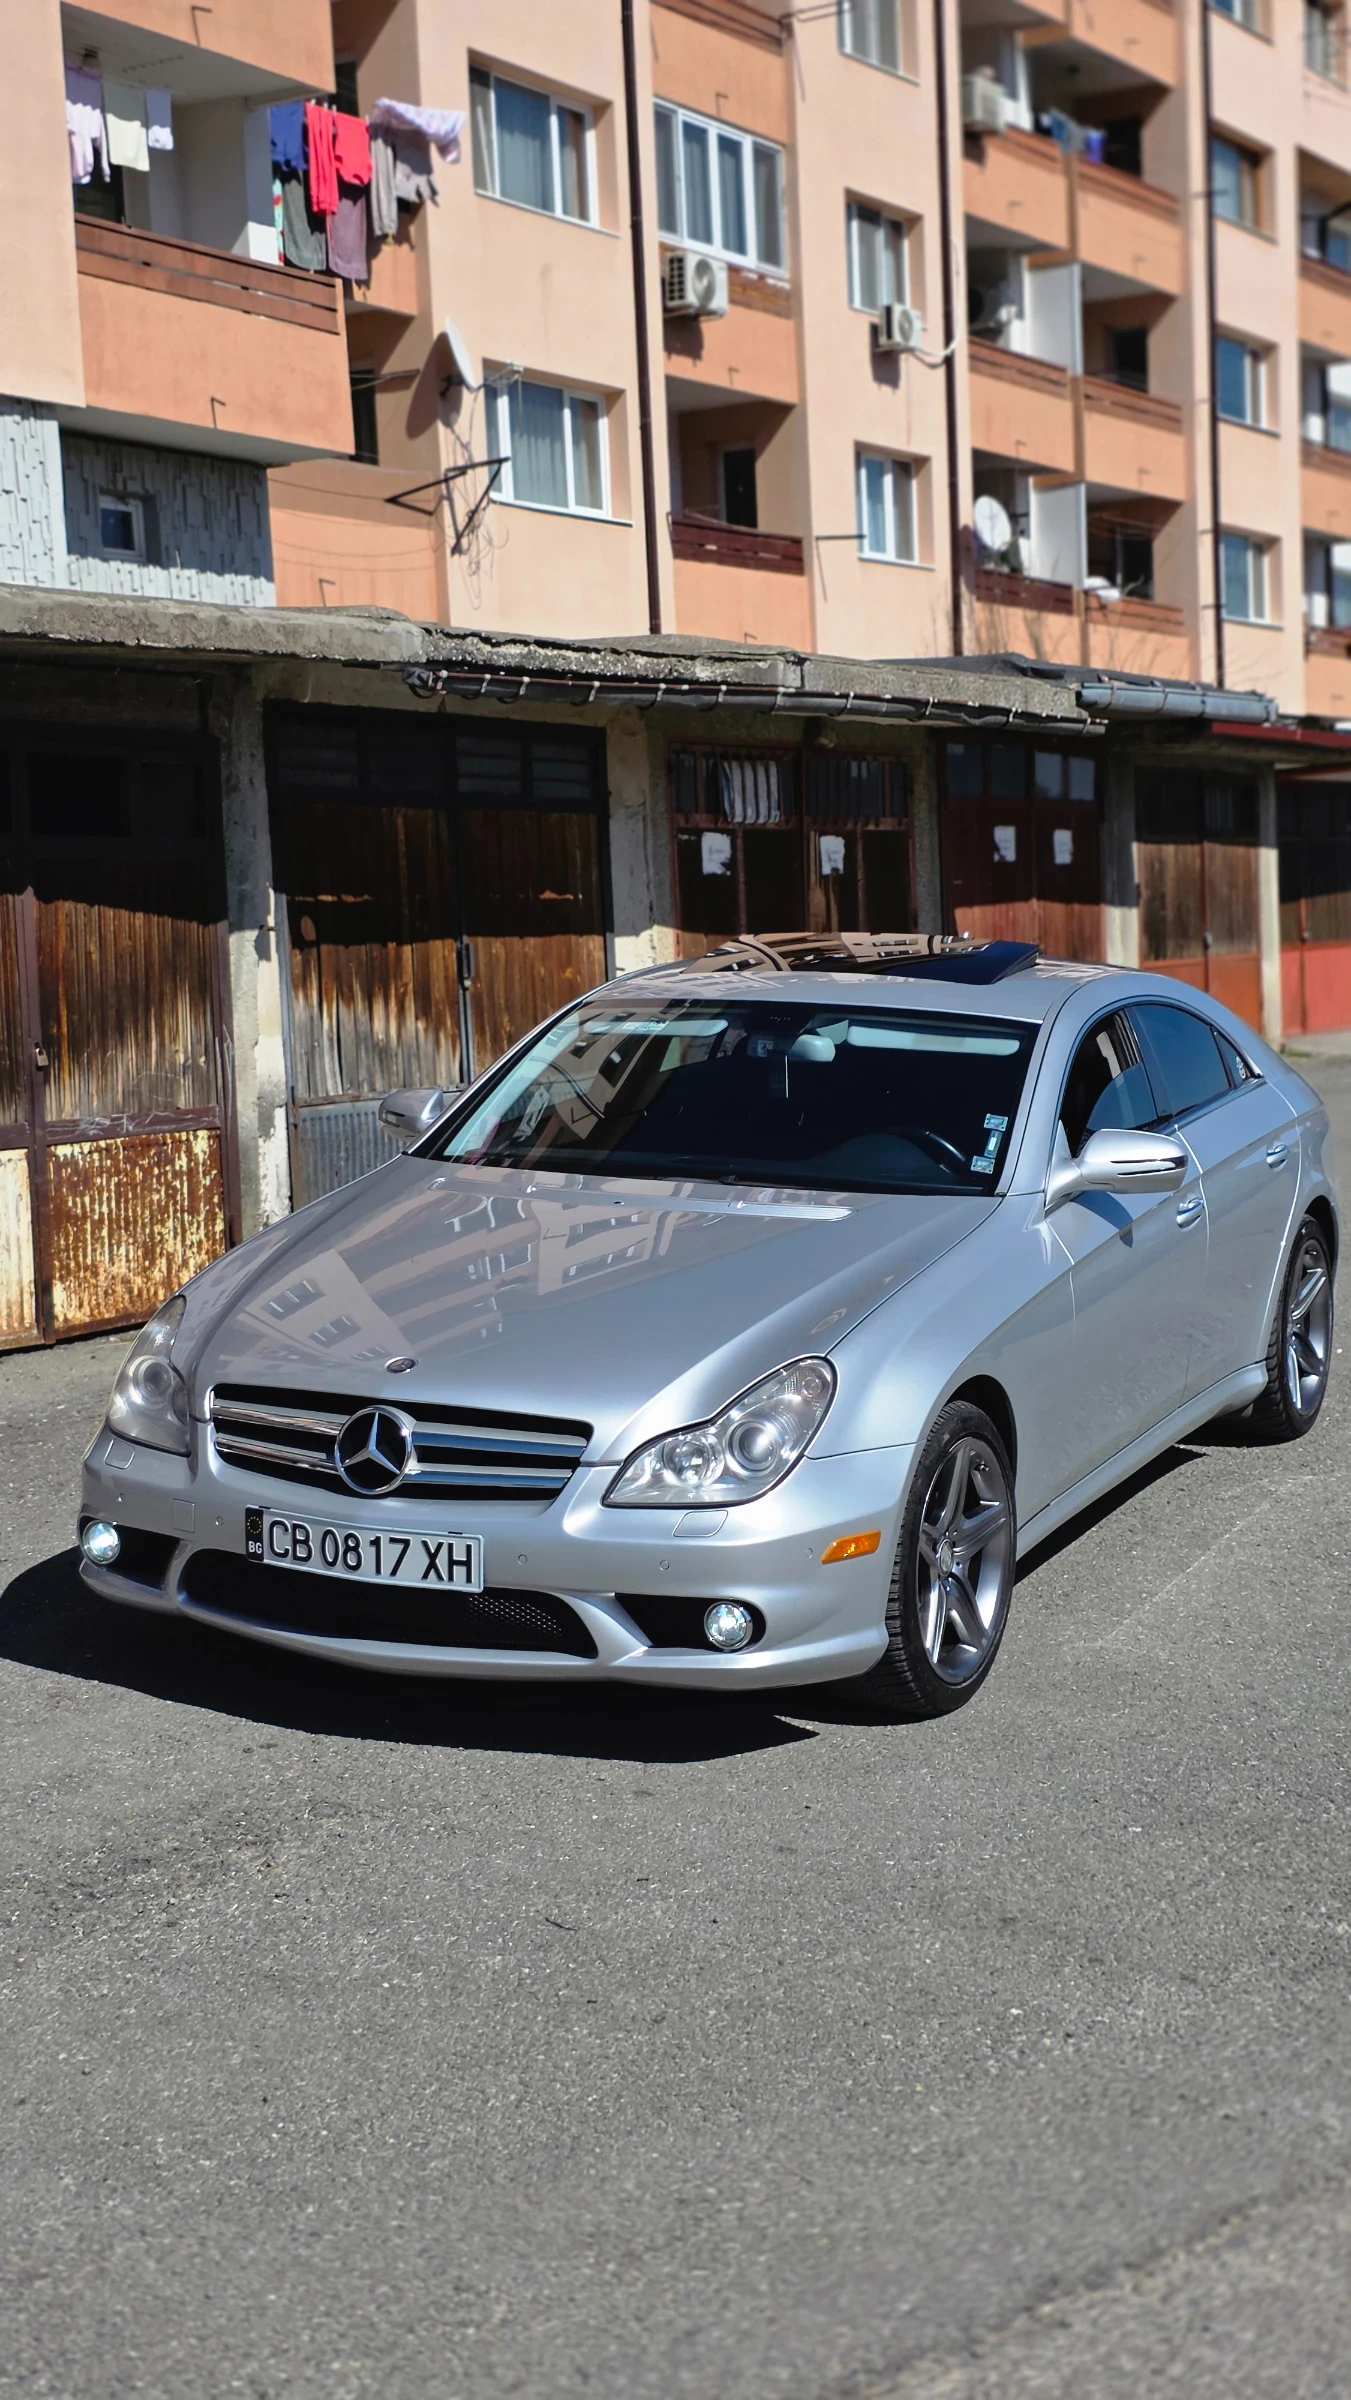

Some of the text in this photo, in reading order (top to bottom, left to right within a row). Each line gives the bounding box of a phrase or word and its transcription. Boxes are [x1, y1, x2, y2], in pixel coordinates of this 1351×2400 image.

[248, 1540, 263, 1554] BG
[268, 1518, 473, 1584] CB 0817 XH
